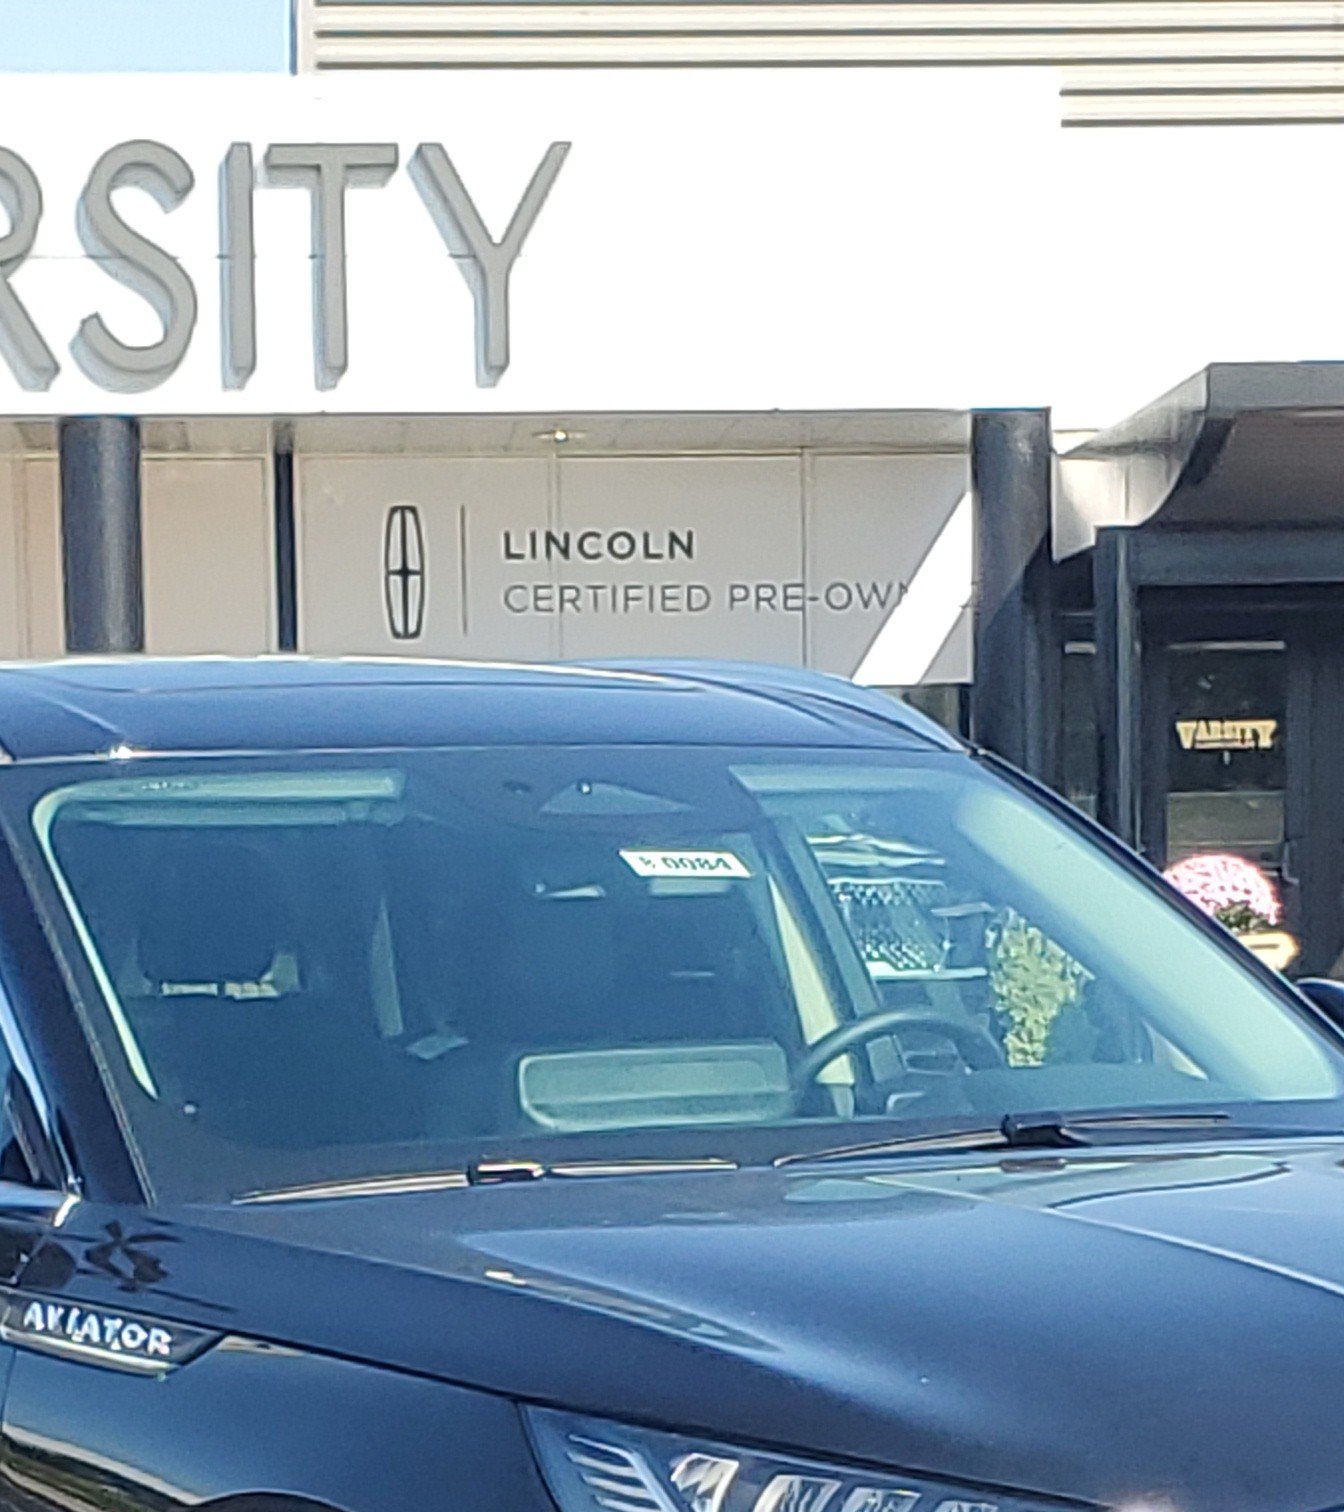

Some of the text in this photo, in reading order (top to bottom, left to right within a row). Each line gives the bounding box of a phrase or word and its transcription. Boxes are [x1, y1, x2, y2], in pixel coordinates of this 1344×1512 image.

[502, 530, 695, 561] LINCOLN
[503, 584, 712, 613] CERTIFIED
[1175, 719, 1277, 750] VARSITY
[22, 1301, 173, 1356] AVIATOR
